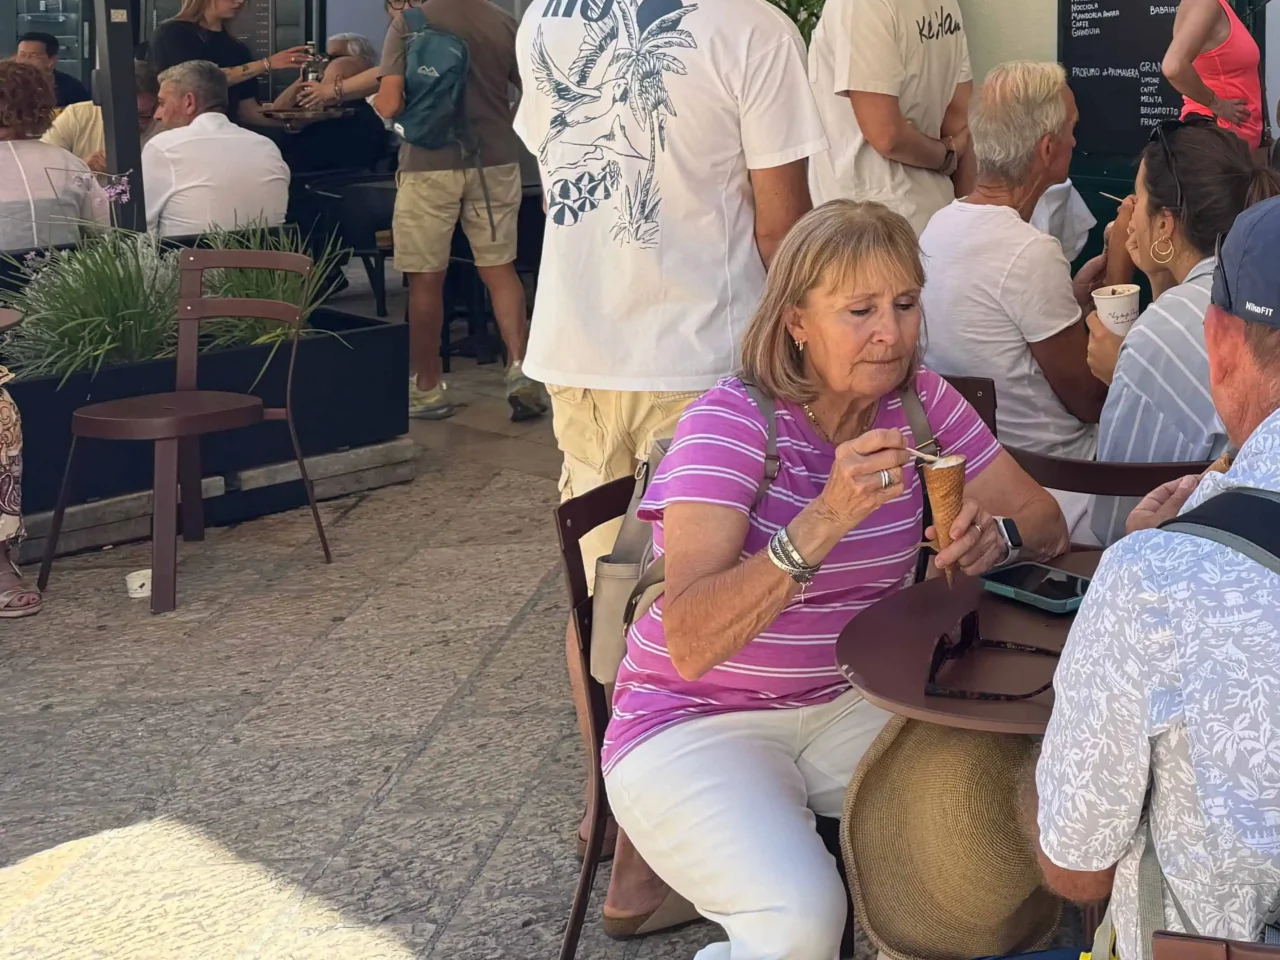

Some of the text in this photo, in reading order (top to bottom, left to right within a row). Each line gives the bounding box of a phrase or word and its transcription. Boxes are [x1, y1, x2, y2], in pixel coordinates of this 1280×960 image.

[1071, 2, 1099, 13] NOCCIOLA
[1139, 61, 1163, 73] GRAN
[1140, 95, 1163, 104] MENTA
